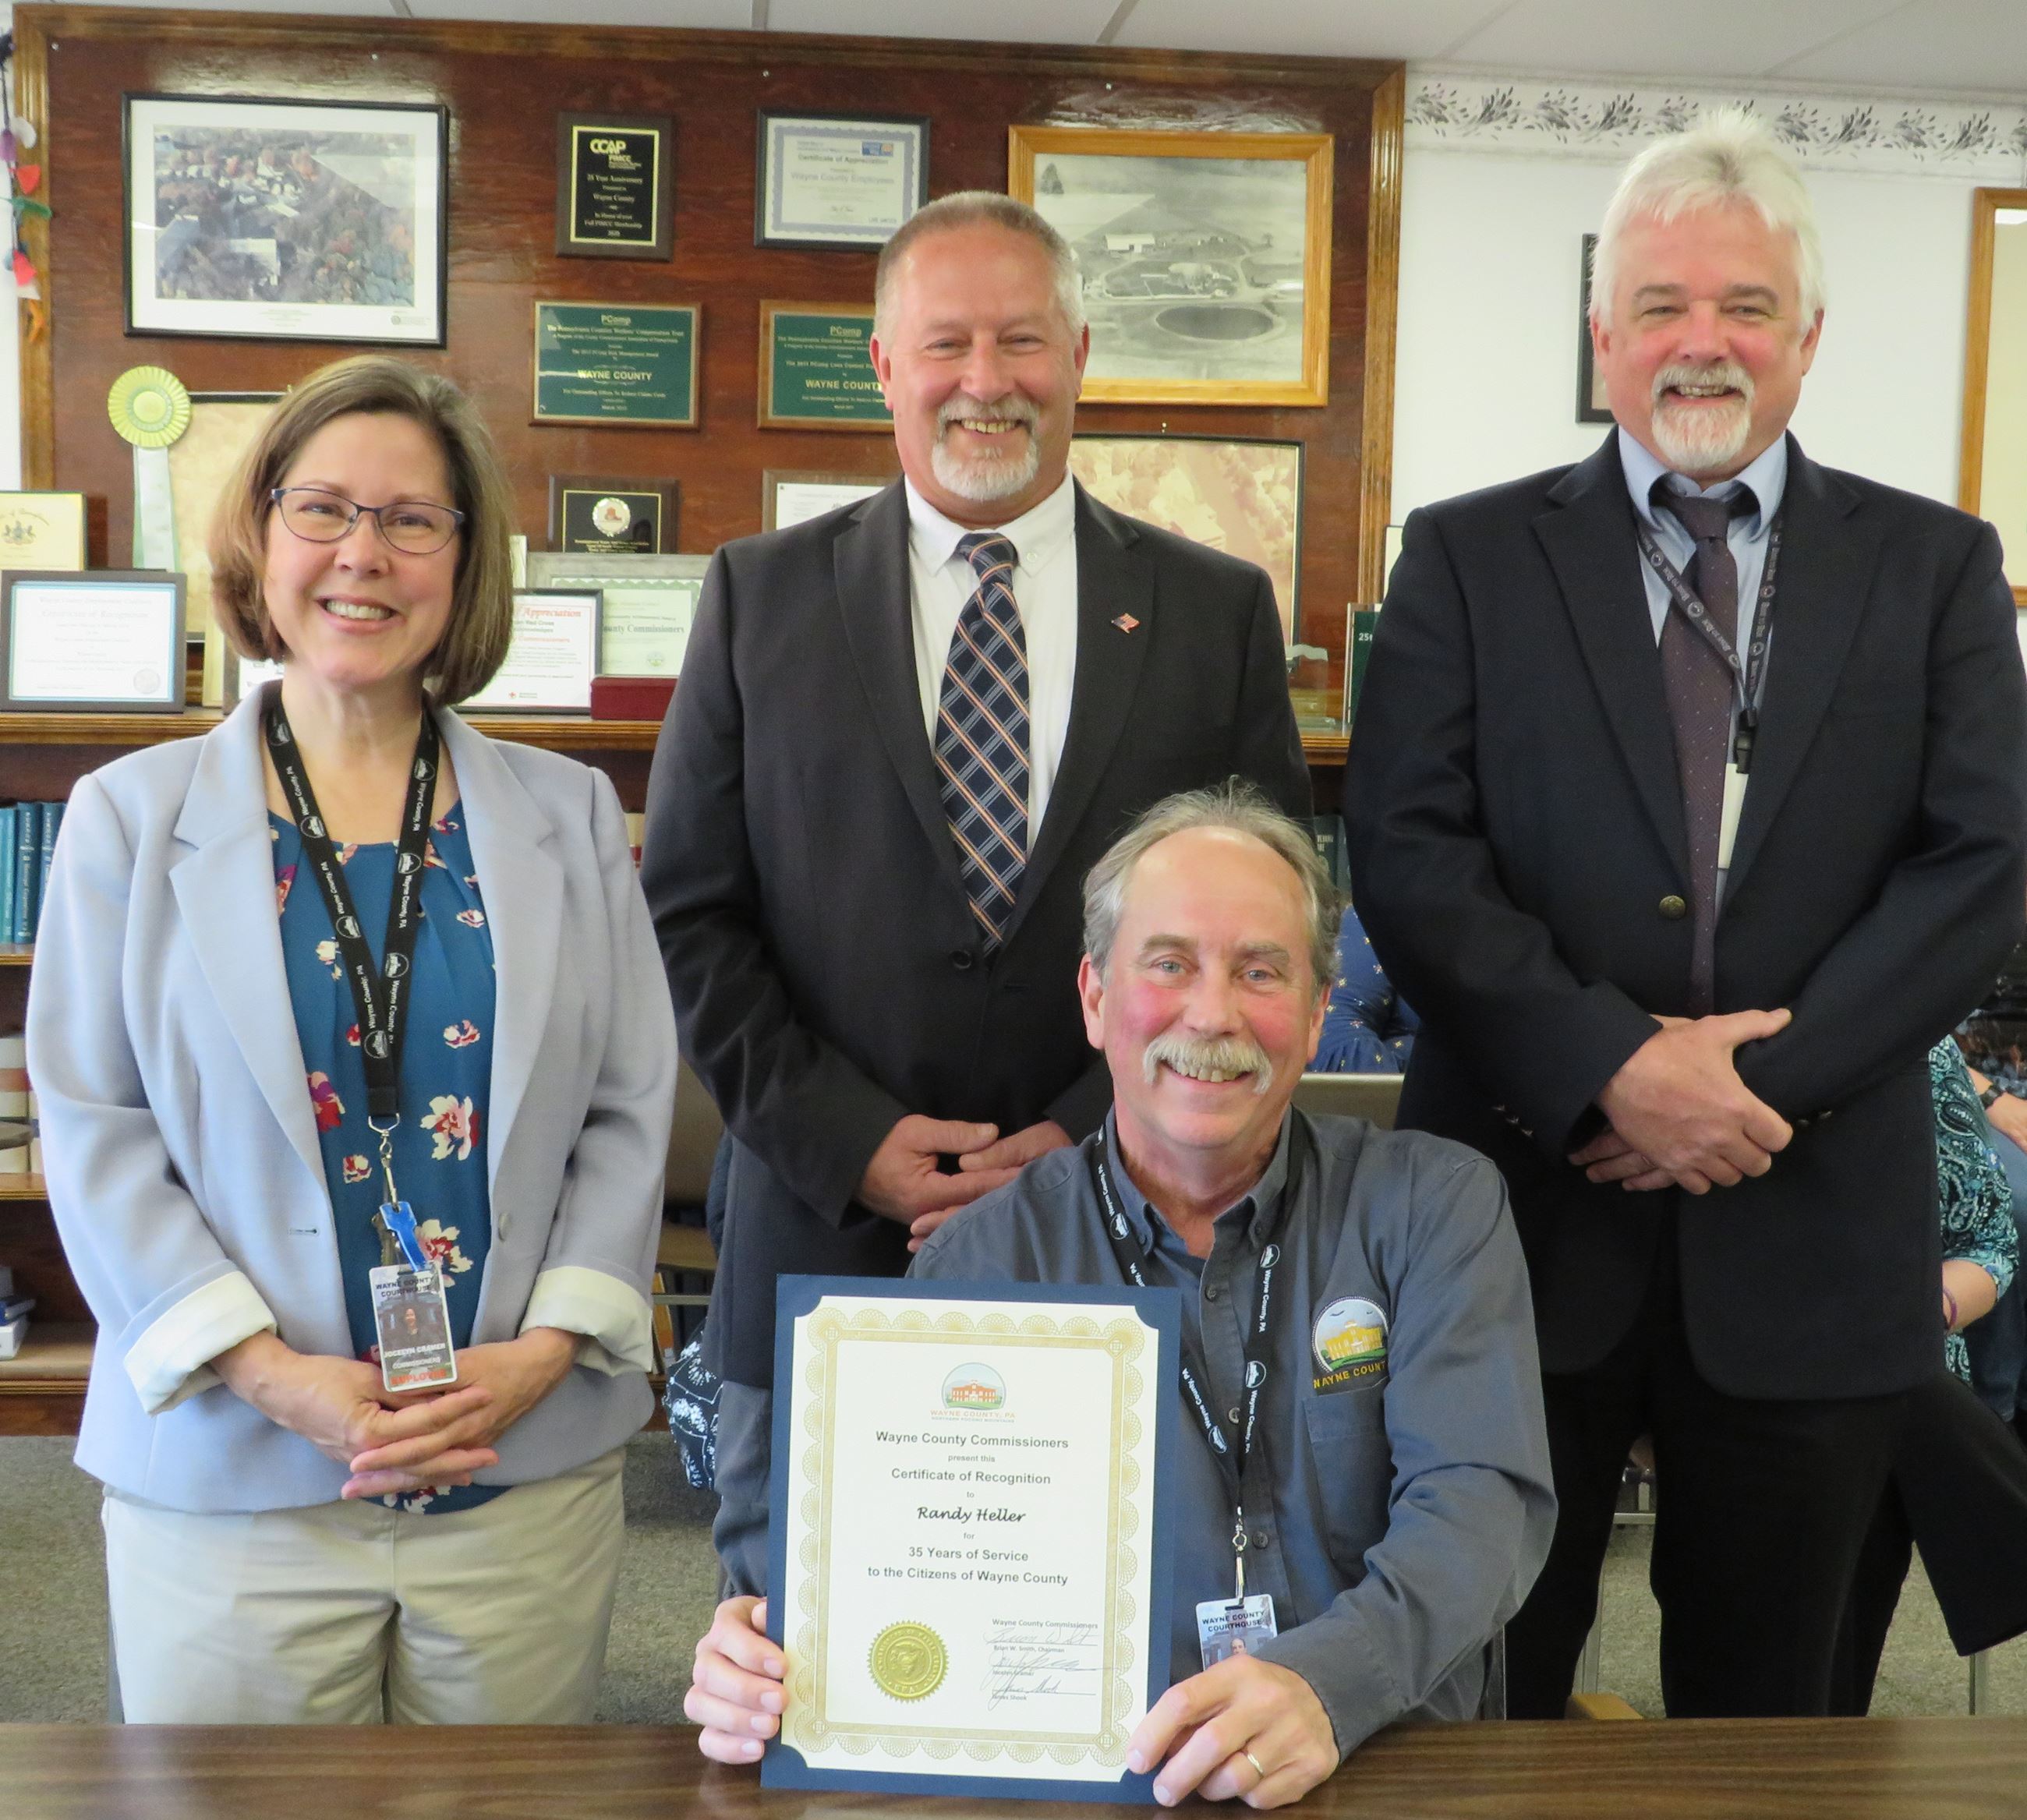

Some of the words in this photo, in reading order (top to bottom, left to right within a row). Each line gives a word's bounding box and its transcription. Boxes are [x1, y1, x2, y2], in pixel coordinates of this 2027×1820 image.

[589, 139, 626, 154] CCAP
[578, 369, 611, 379] WAYNE
[613, 370, 652, 381] COUNTY
[805, 379, 840, 389] WAYNE
[523, 608, 582, 619] Appreciation
[603, 624, 624, 634] ounty
[627, 624, 685, 634] Commissioners
[1358, 632, 1373, 641] 25t
[285, 765, 294, 775] PA
[417, 782, 426, 801] Wayne
[299, 797, 310, 816] Wayne
[412, 822, 421, 832] PA
[320, 861, 328, 871] PA
[326, 871, 338, 894] County,
[402, 875, 412, 896] Wayne
[334, 894, 345, 915] Wayne
[401, 896, 410, 918] County,
[398, 919, 407, 928] PA
[356, 965, 364, 974] PA
[361, 976, 371, 1003] County,
[390, 980, 400, 1005] Wayne
[367, 1003, 377, 1029] Wayne
[388, 1005, 398, 1032] County
[1098, 1163, 1104, 1175] PA
[1100, 1172, 1109, 1196] County,
[1105, 1195, 1116, 1217] Wayne
[1130, 1262, 1137, 1274] PA
[375, 1281, 401, 1290] WAYNE
[404, 1276, 433, 1286] COUNTY
[1262, 1269, 1272, 1294] Wayne
[381, 1286, 432, 1298] COURTHOUSE
[1259, 1294, 1270, 1321] County,
[1259, 1321, 1266, 1333] PA
[384, 1347, 416, 1359] JOCELYN
[416, 1343, 447, 1355] CRAMER
[1182, 1367, 1190, 1380] PA
[1353, 1360, 1386, 1376] COUNT
[1187, 1377, 1202, 1405] County,
[1249, 1390, 1258, 1415] Wayne
[1197, 1404, 1212, 1429] Wayne
[1246, 1415, 1255, 1440] County,
[876, 1430, 918, 1444] Wayne
[922, 1433, 967, 1447] County
[971, 1434, 1069, 1448] Commissioners
[948, 1454, 978, 1462] present
[891, 1468, 955, 1481] Certificate
[959, 1470, 973, 1482] of
[975, 1471, 1051, 1485] Recognition
[916, 1506, 972, 1524] Randy
[976, 1507, 1027, 1522] Heller
[963, 1532, 975, 1540] for
[908, 1546, 923, 1557] 35
[927, 1547, 961, 1559] Years
[966, 1549, 978, 1560] of
[982, 1550, 1028, 1561] Service
[868, 1567, 880, 1577] to
[884, 1567, 903, 1578] the
[907, 1567, 957, 1580] Citizens
[960, 1570, 974, 1581] of
[977, 1571, 1020, 1584] Wayne
[1023, 1573, 1068, 1587] County
[1018, 1620, 1043, 1628] County
[1045, 1620, 1098, 1629] Commissioners
[1202, 1614, 1229, 1625] WAYNE
[1233, 1610, 1265, 1620] COUNTY
[1208, 1619, 1264, 1632] COURTHOUSE
